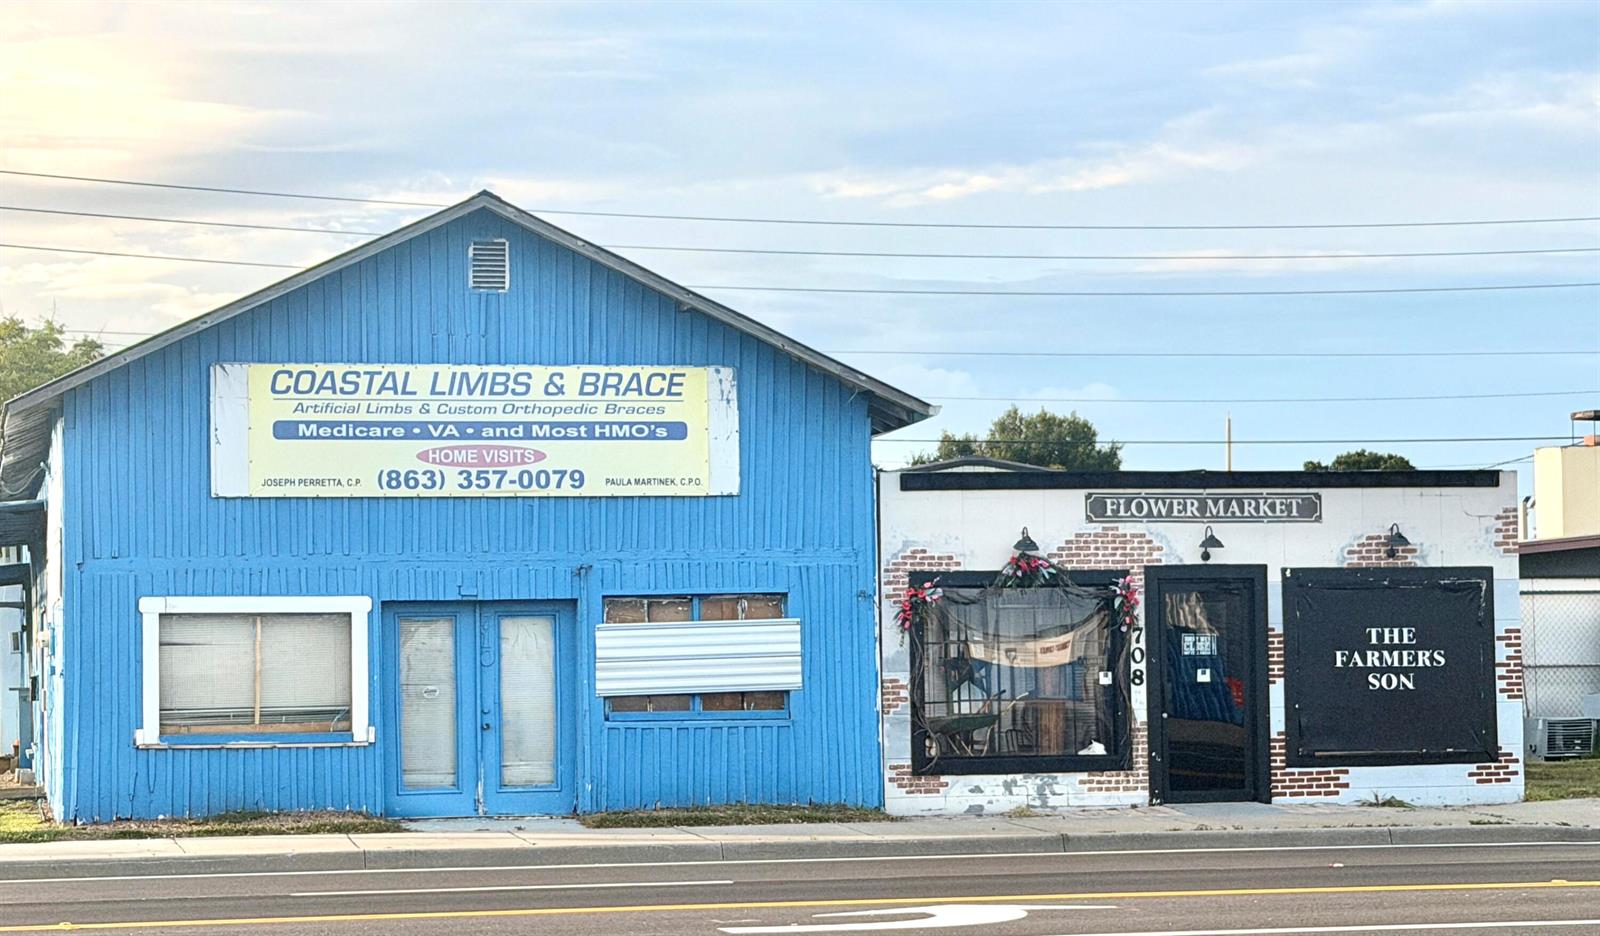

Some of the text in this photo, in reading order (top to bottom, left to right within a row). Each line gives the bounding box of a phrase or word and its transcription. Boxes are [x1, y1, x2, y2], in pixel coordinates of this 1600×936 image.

[271, 370, 686, 396] COASTAL LIMBS & BRACE
[293, 403, 665, 417] Artificial Limbs & Custom Orthopedic Braces
[299, 424, 667, 437] Medicare VA and Most HMO's
[428, 449, 535, 464] HOME VISITS
[298, 479, 344, 487] PERRETTA,
[378, 470, 584, 490] (863) 357-0079
[606, 478, 703, 487] PAULA MARTINEK, C.P.O.
[1105, 499, 1302, 517] FLOWER MARKET
[1366, 628, 1416, 644] THE
[1131, 627, 1145, 686] 708
[1336, 650, 1445, 667] FARMER'S
[1368, 673, 1414, 689] SON
